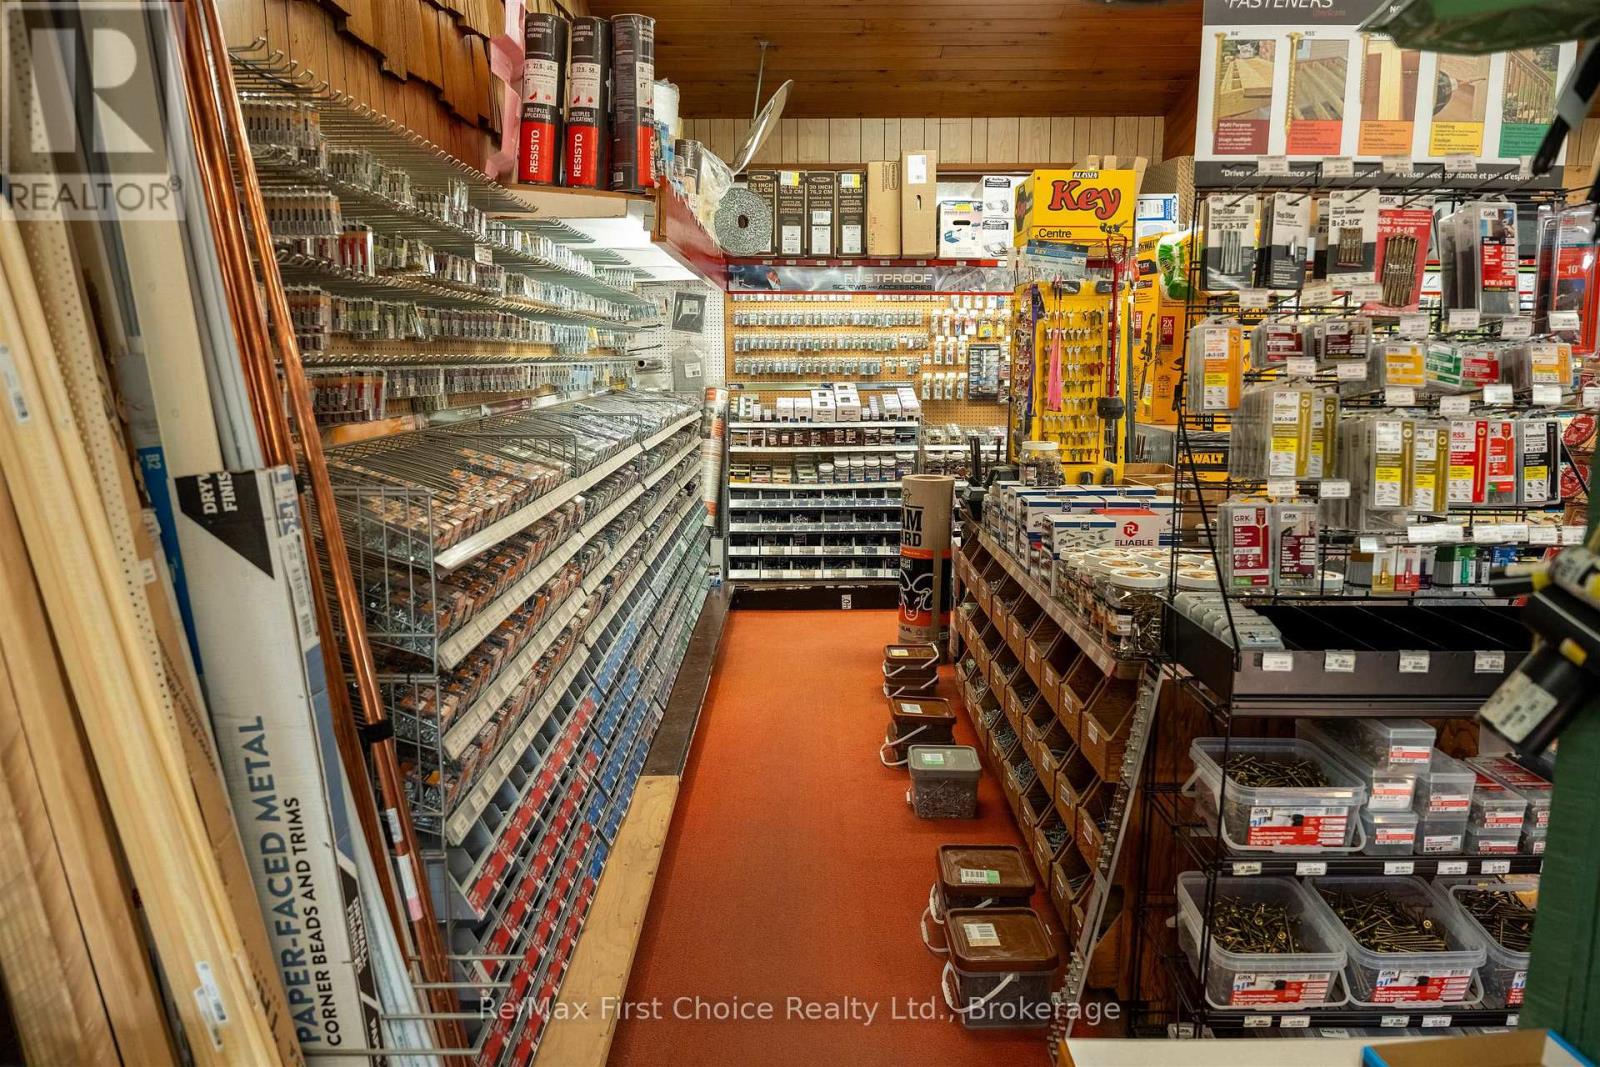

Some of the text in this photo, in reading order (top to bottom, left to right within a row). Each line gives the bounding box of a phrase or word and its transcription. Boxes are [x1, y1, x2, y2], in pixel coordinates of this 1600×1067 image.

[530, 130, 540, 174] RESISTO
[573, 134, 583, 177] RESISTO
[1048, 180, 1122, 221] Key
[1039, 228, 1072, 238] Centre
[1115, 539, 1154, 547] ELIABLE
[238, 716, 322, 1044] PAPER-FACED METAL
[284, 797, 342, 1047] CORNER BEADS AND TRIMS
